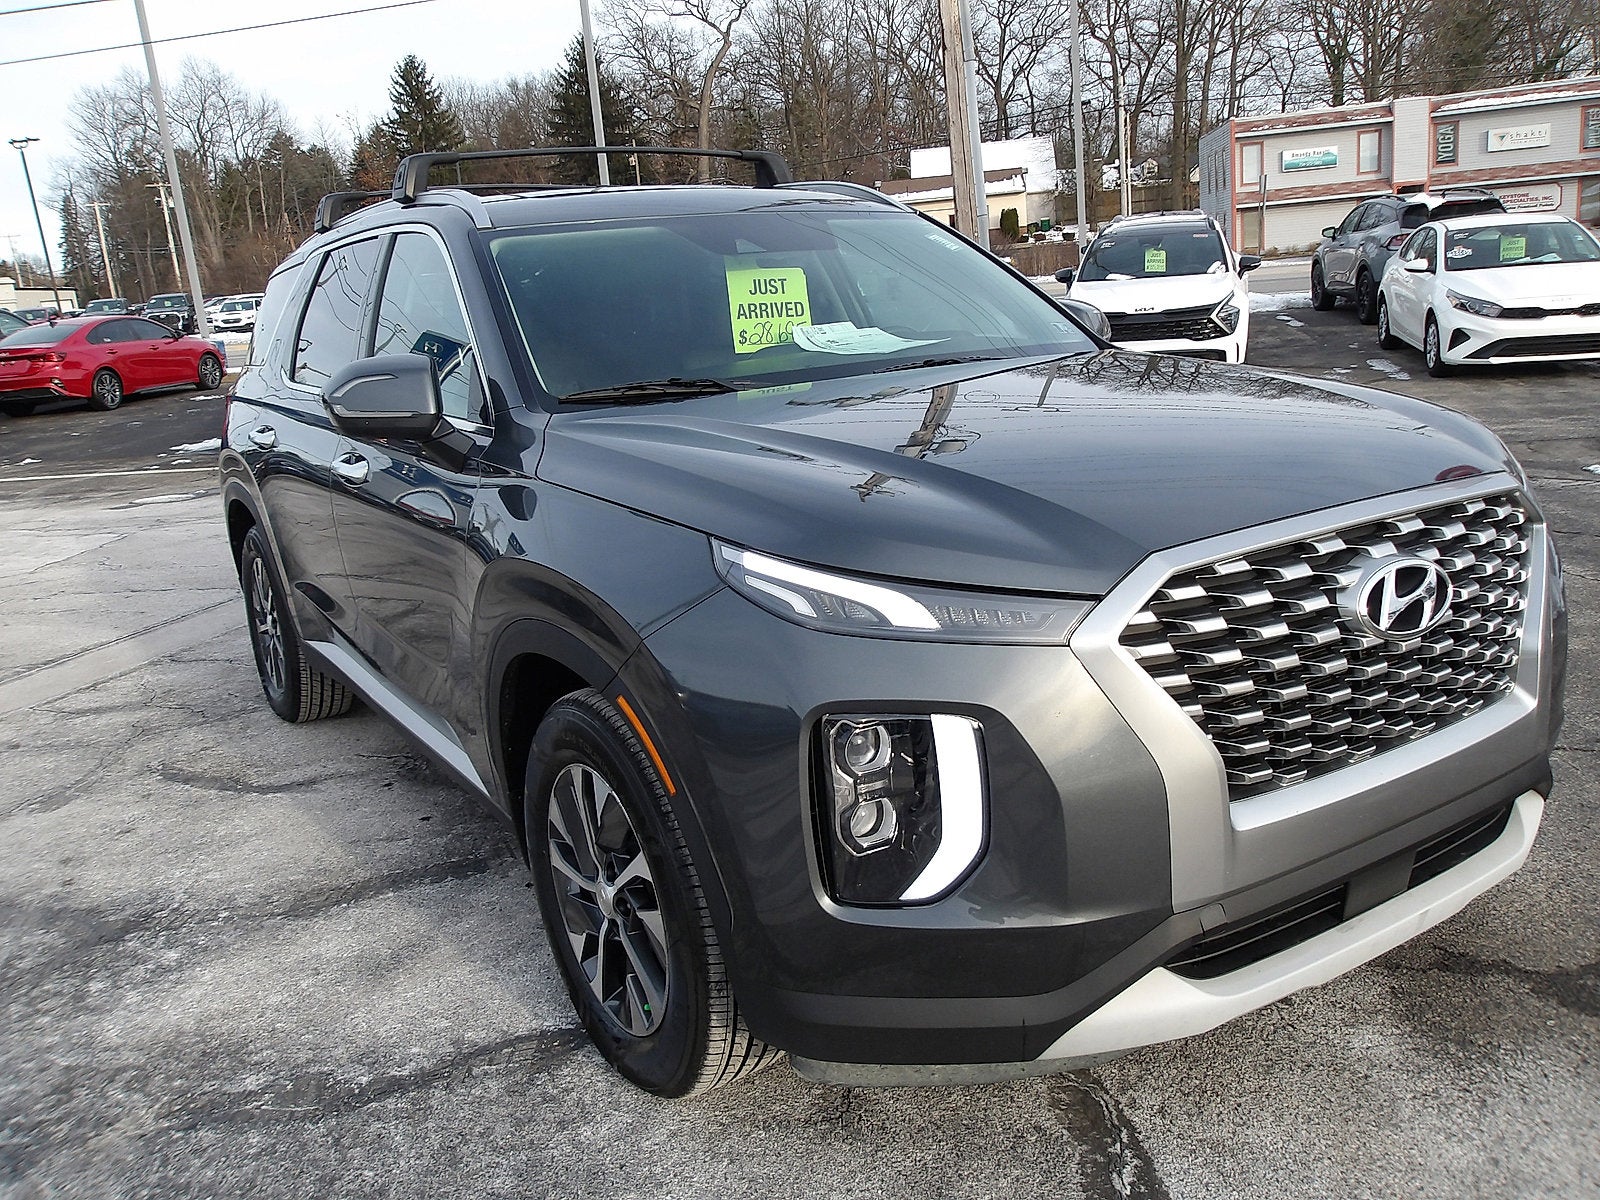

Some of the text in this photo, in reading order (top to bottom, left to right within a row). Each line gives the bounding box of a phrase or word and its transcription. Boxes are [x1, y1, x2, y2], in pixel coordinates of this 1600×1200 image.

[1438, 125, 1455, 161] YOGA
[1499, 192, 1530, 200] KEYSTONE
[748, 278, 787, 296] JUST
[736, 301, 805, 320] ARRIVED
